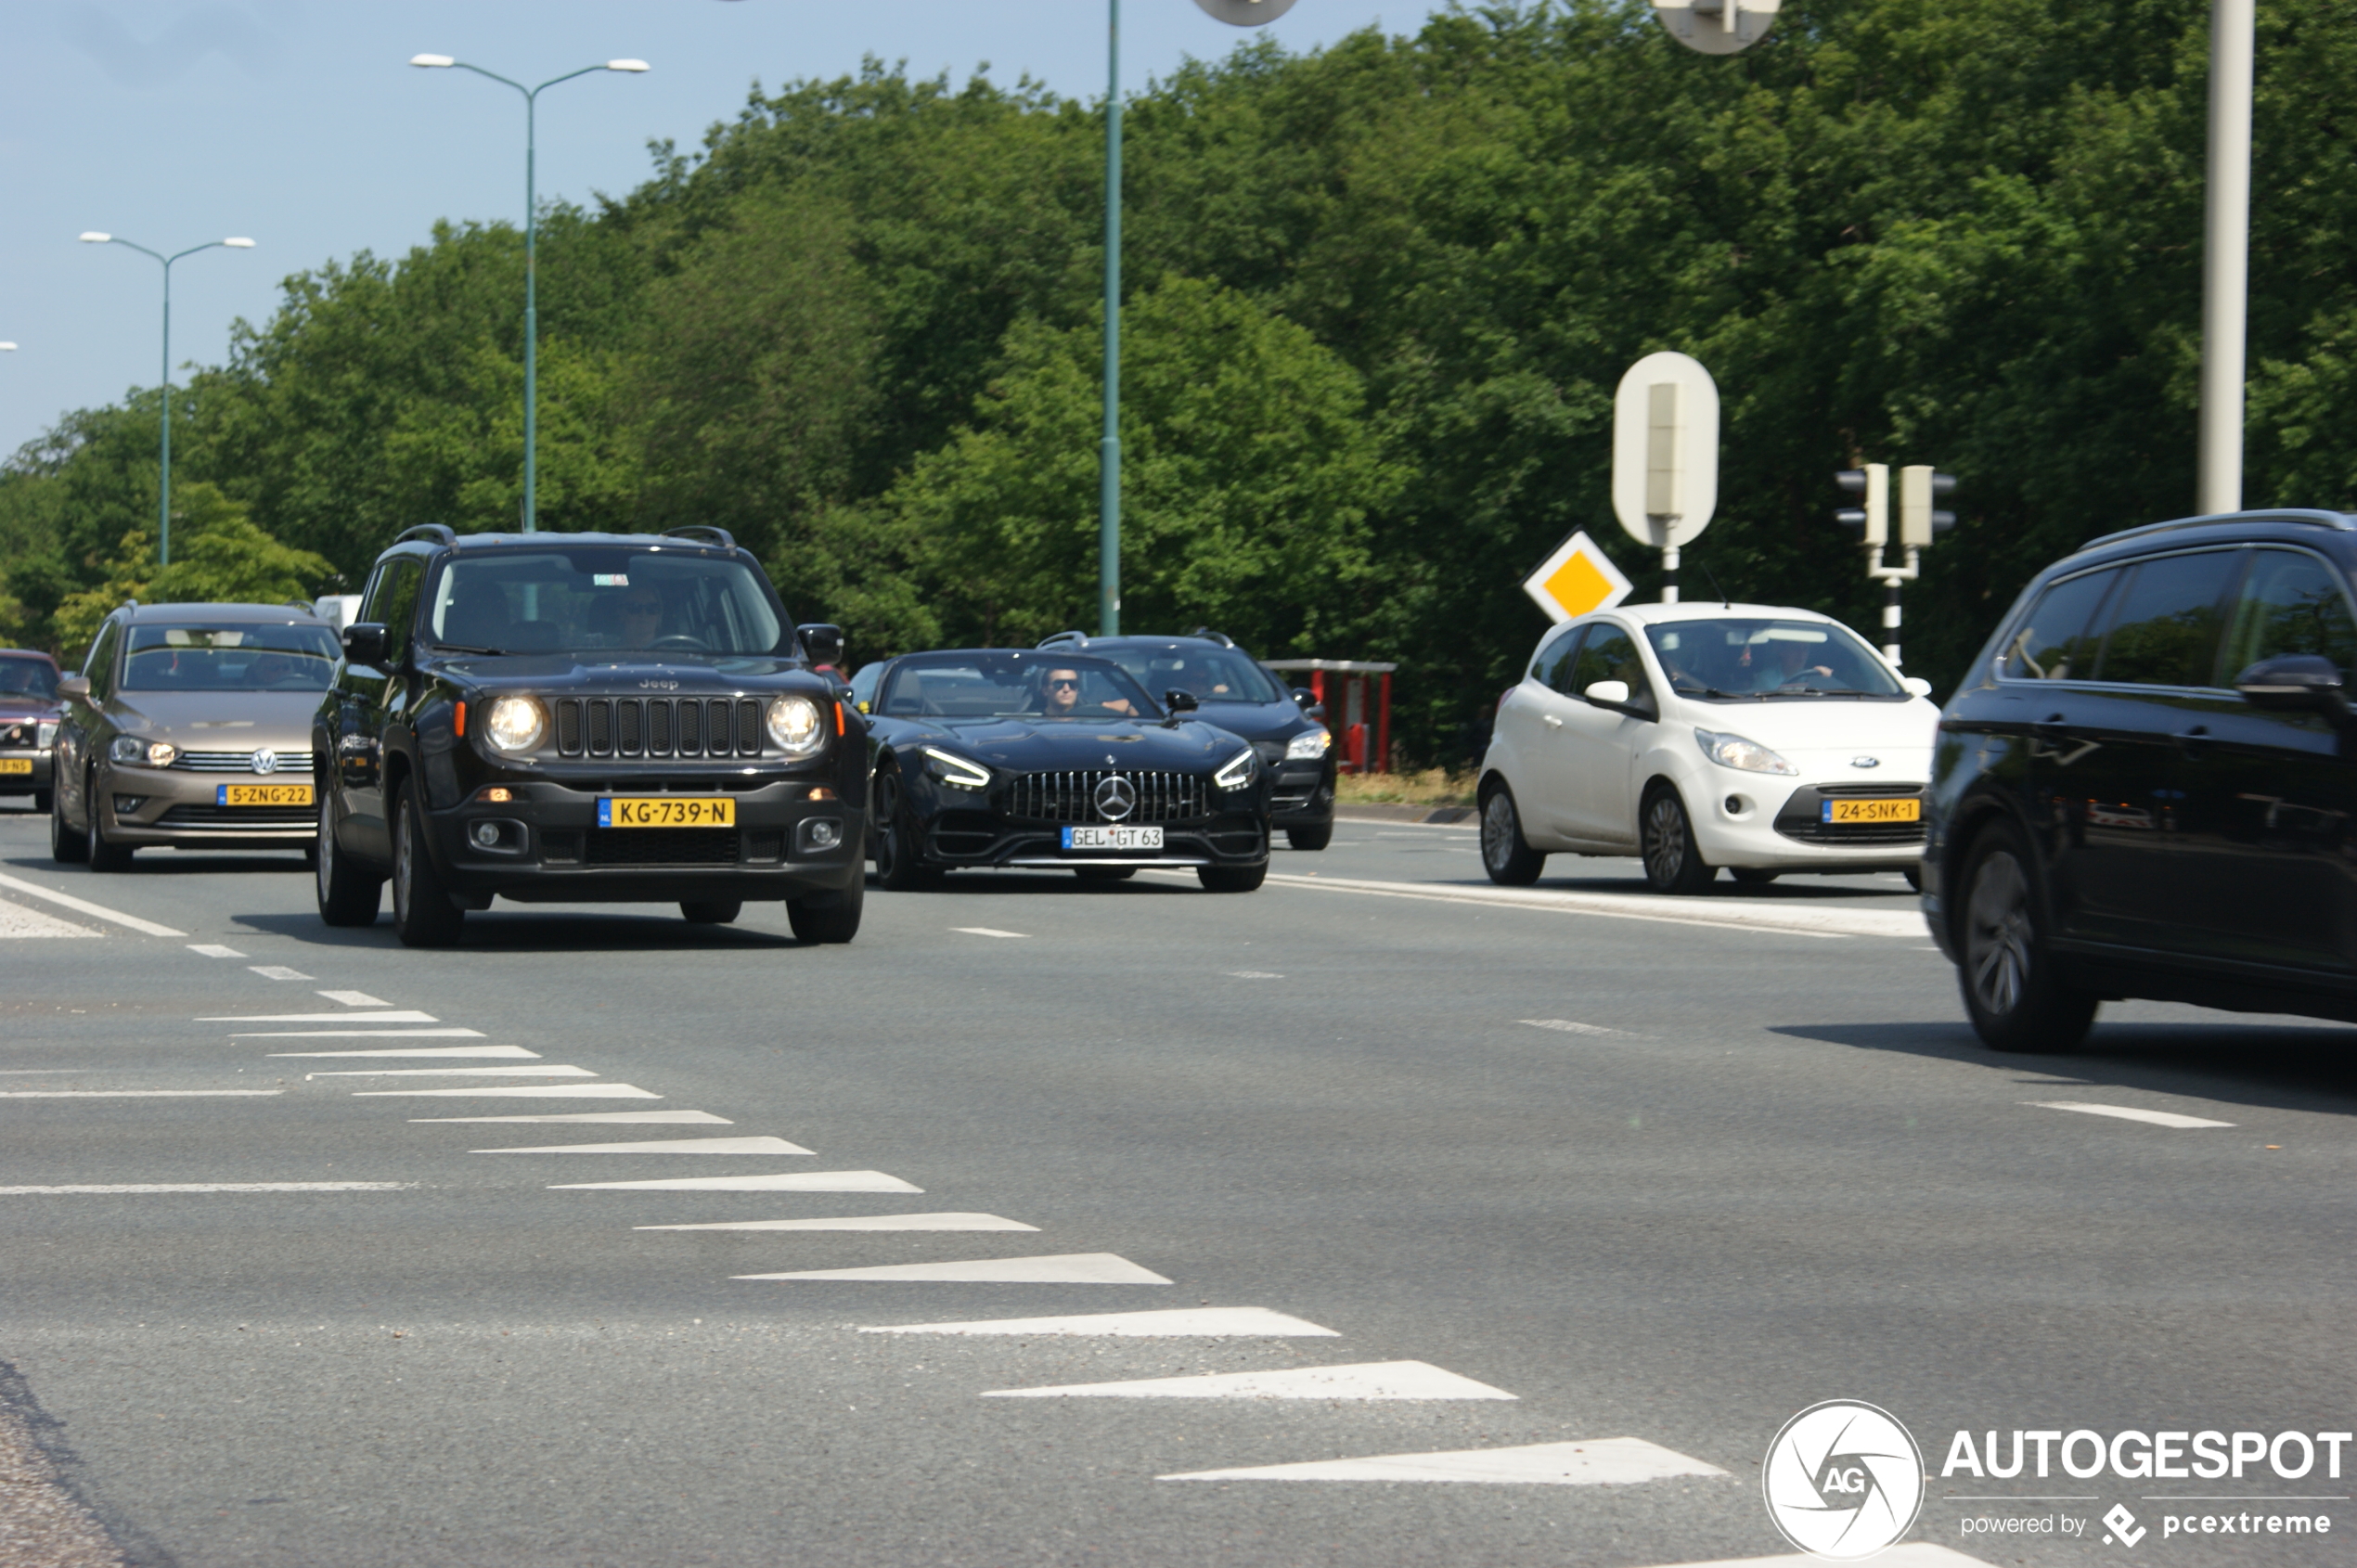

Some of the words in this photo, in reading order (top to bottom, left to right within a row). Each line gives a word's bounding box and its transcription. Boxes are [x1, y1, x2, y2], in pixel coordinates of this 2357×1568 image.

[639, 678, 678, 690] Jeep
[233, 788, 306, 802] 5-ZNG-22
[621, 803, 725, 823] KG-739-N
[1840, 803, 1913, 819] 24-SNK-1
[1073, 829, 1105, 846] GEL
